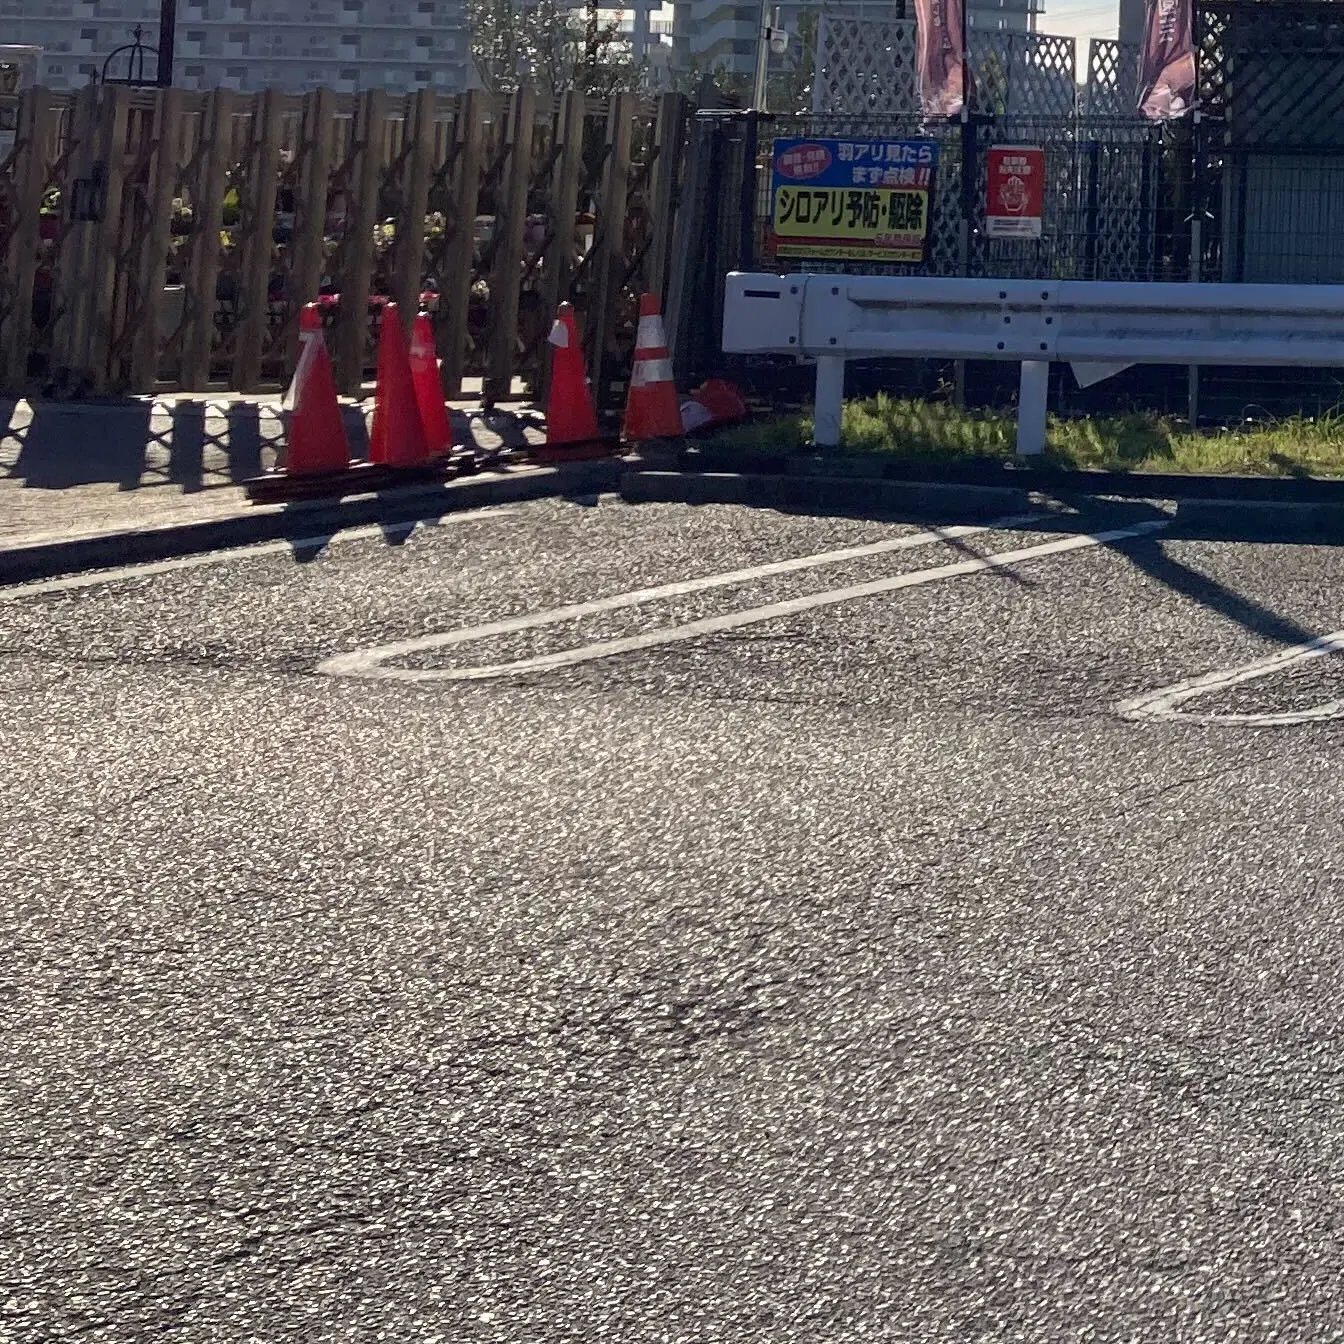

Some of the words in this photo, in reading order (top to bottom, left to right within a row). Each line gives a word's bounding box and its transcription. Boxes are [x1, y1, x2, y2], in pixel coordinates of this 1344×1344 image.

[837, 143, 932, 163] 羽アリ見たら
[779, 189, 924, 231] シロアリ予防・駆除
